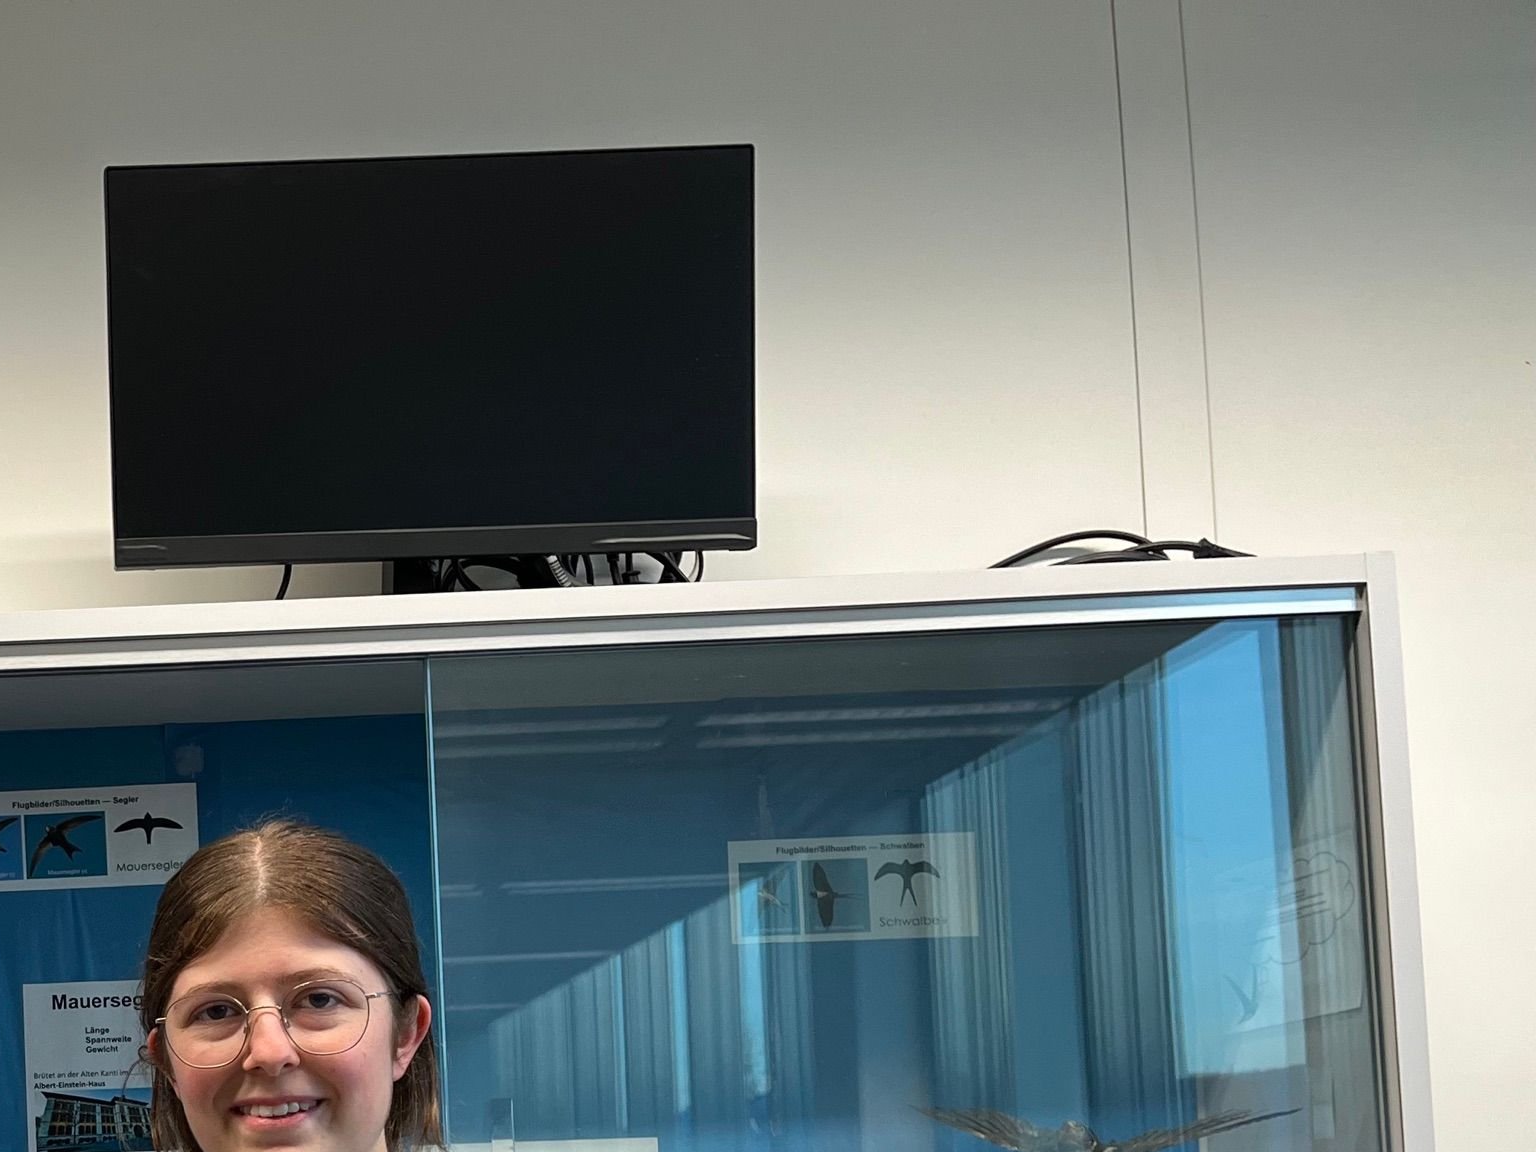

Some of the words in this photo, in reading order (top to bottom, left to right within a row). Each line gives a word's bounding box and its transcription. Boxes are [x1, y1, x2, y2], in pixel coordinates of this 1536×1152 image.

[12, 798, 100, 810] Flugbilder/Silhouetten
[113, 796, 139, 805] Segler
[880, 842, 925, 850] Schwalben
[116, 860, 184, 872] Mauersegler
[52, 994, 144, 1010] Mauerseg
[85, 1026, 110, 1035] Länge
[85, 1036, 132, 1044] Spannweite
[86, 1046, 119, 1054] Gewicht
[34, 1072, 55, 1080] Brütet
[34, 1080, 106, 1090] Albert-Einstein-Haus
